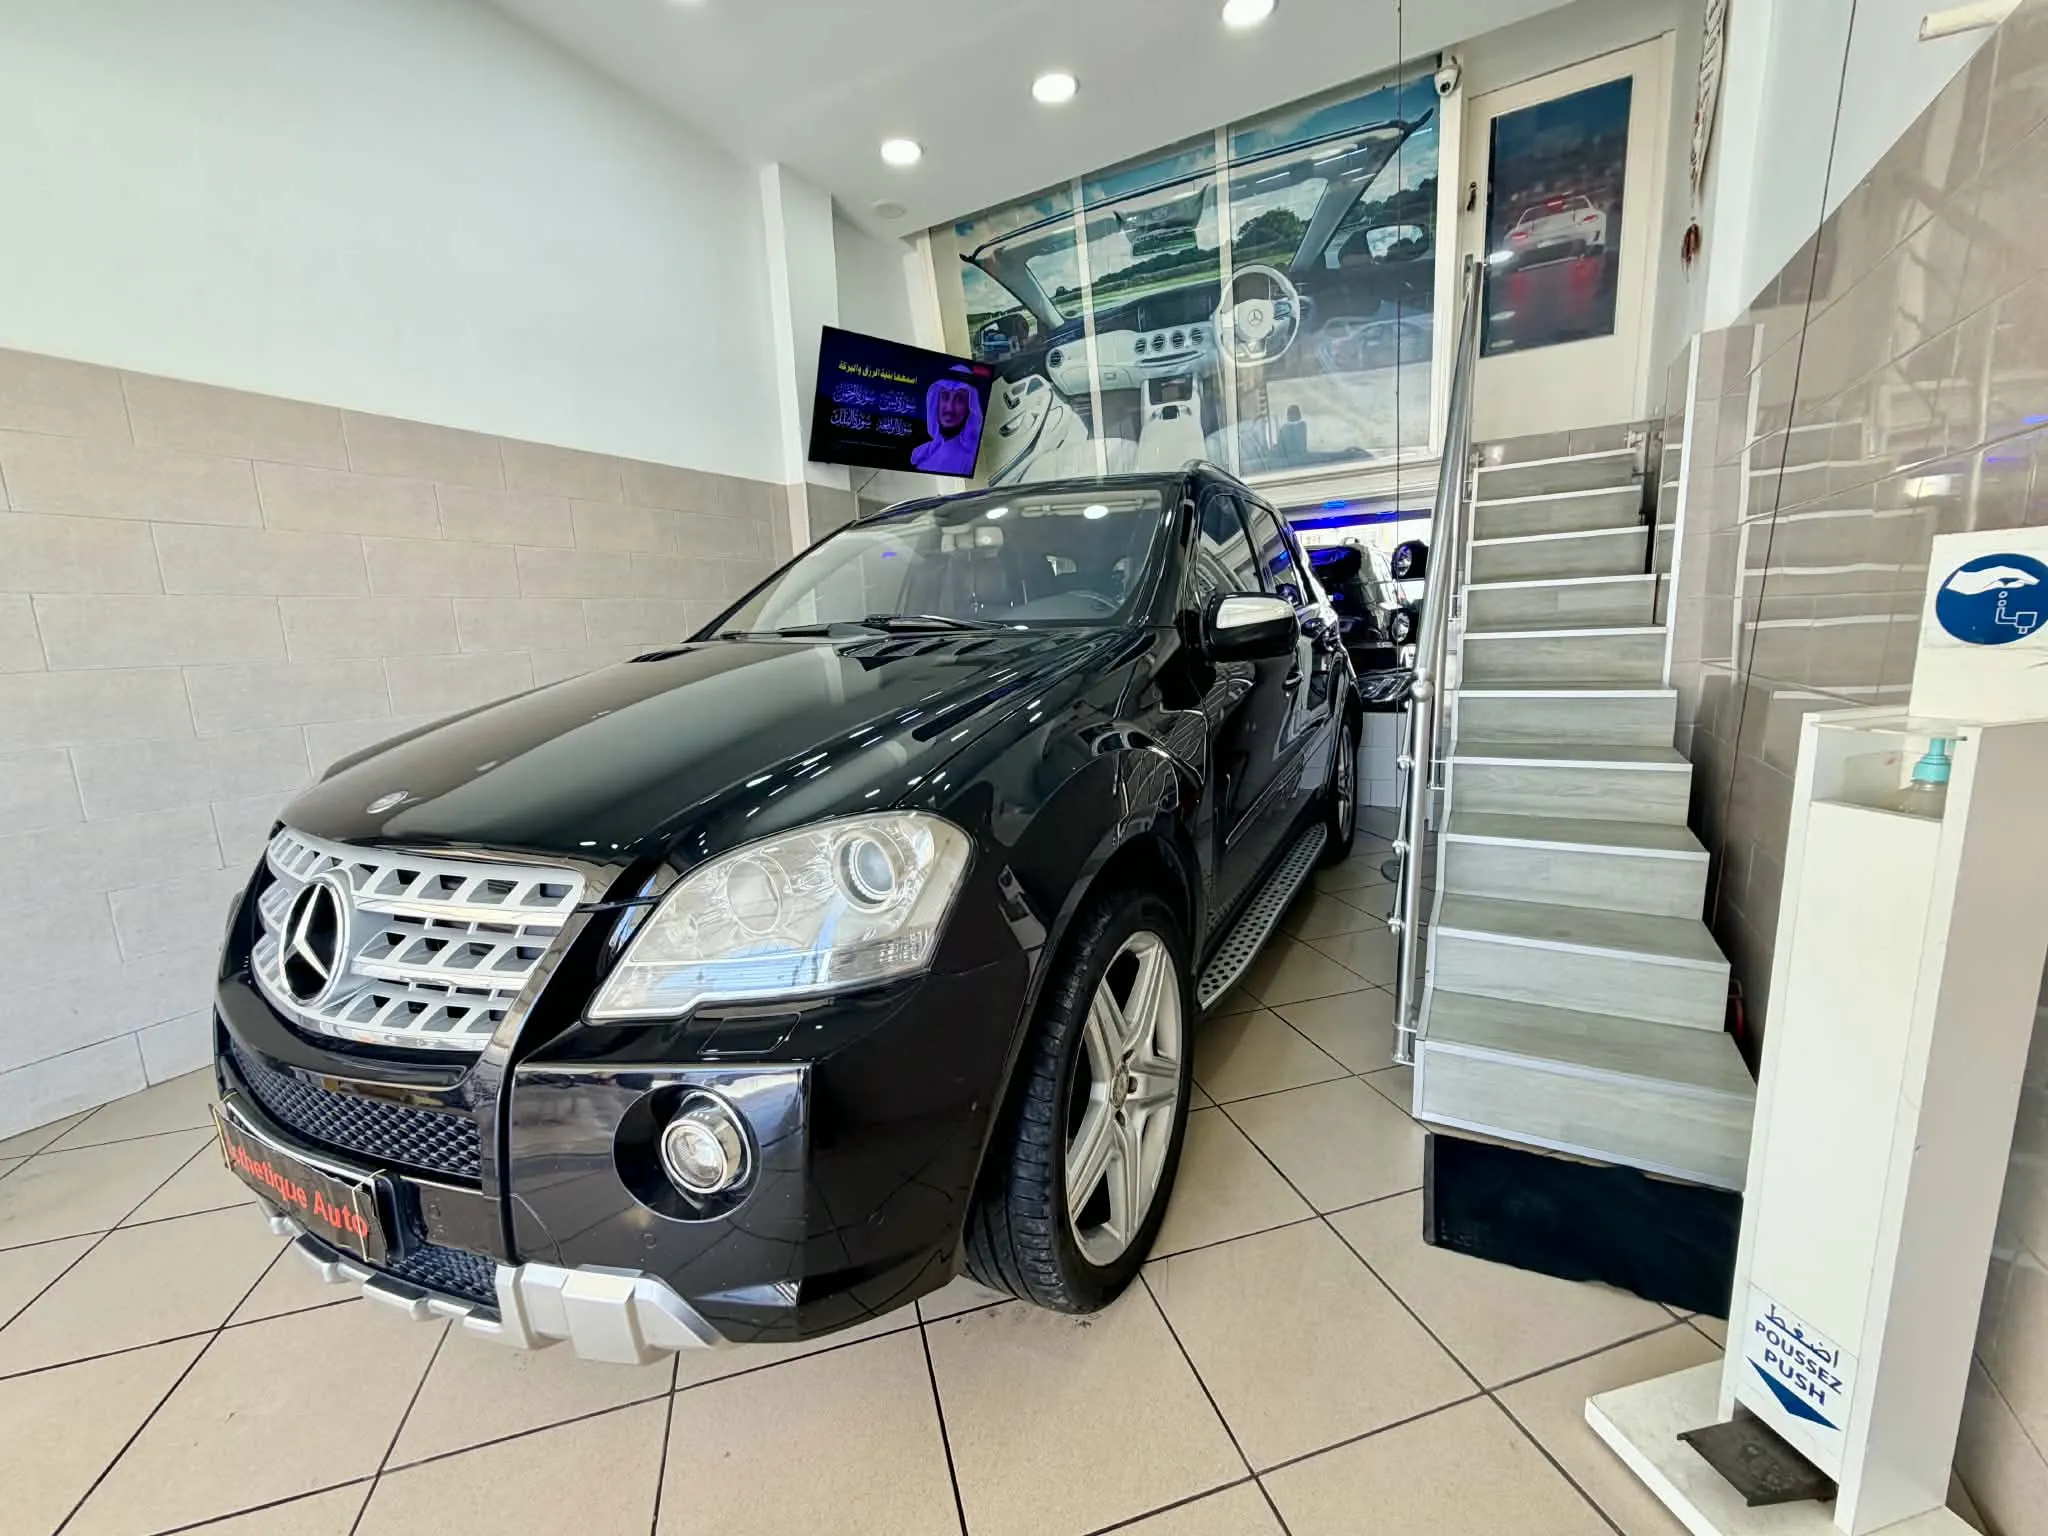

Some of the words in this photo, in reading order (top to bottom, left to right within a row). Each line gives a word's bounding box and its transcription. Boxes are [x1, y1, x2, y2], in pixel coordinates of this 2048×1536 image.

[313, 1190, 369, 1238] Auto
[1755, 1320, 1842, 1394] POUSSEZ
[1764, 1303, 1839, 1368] اضغط
[1764, 1348, 1825, 1406] PUSH
